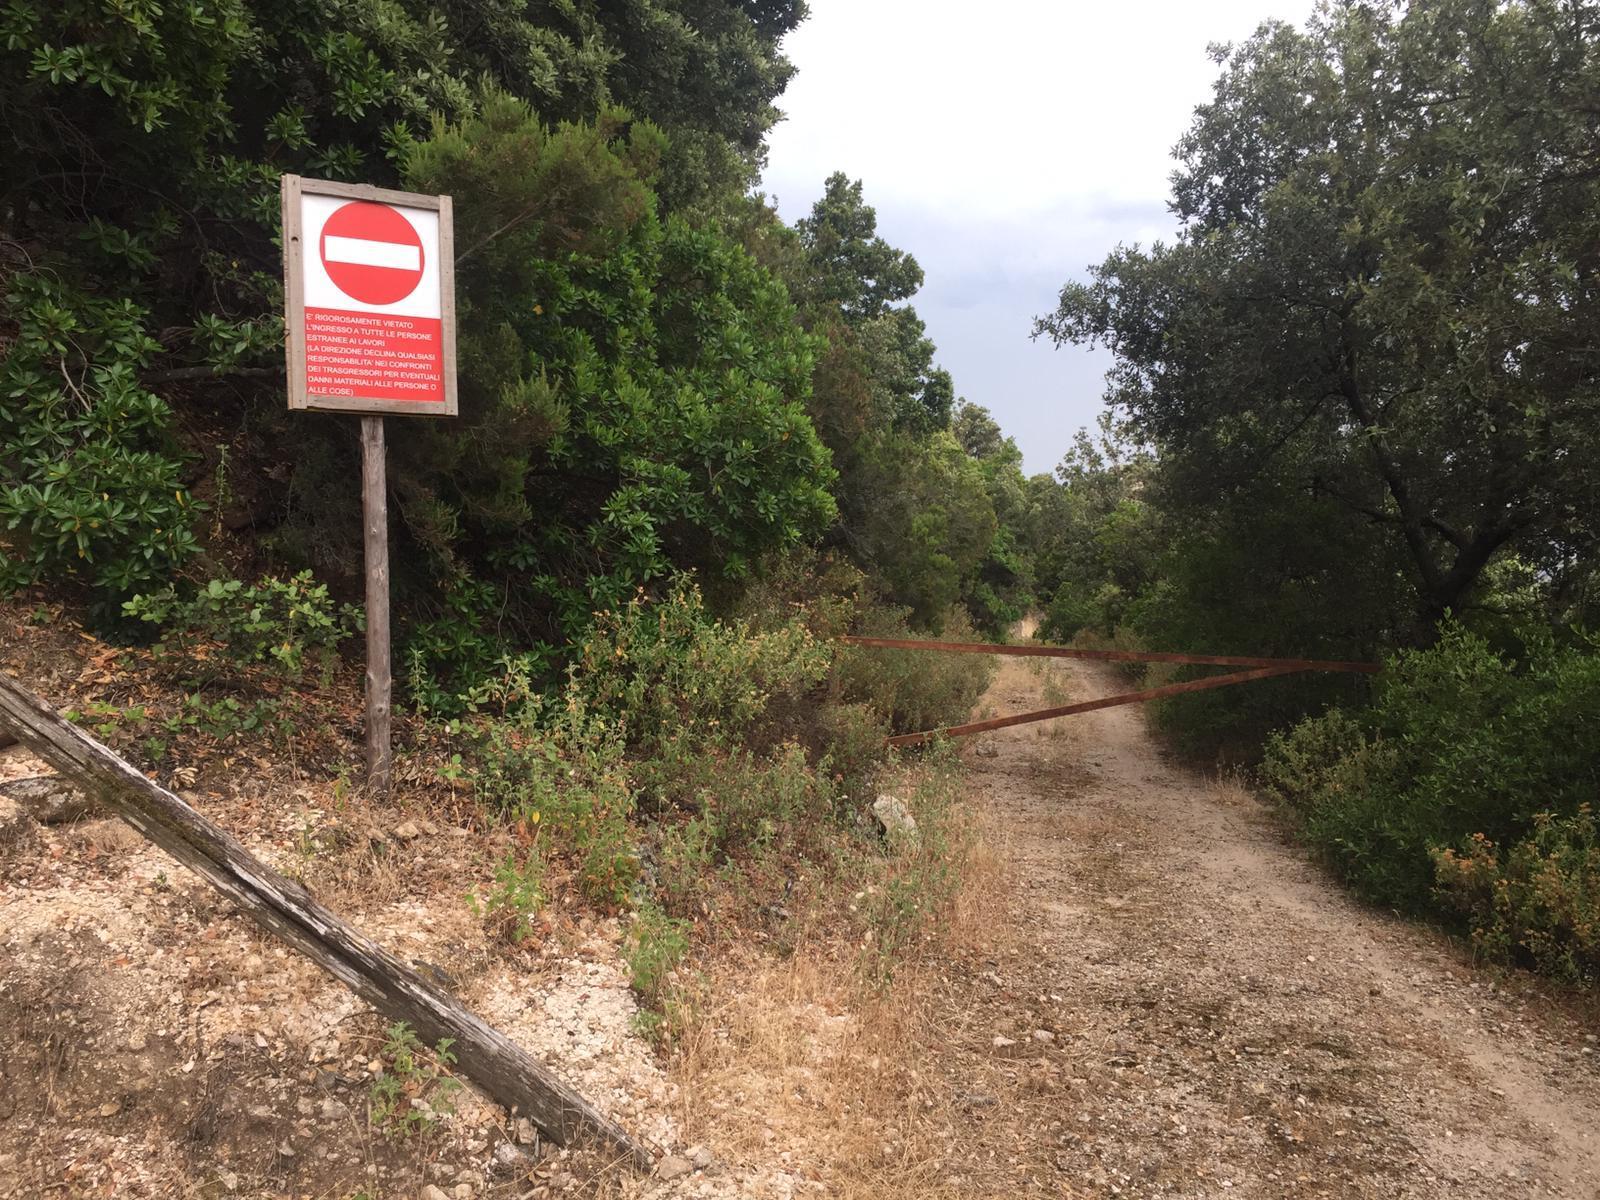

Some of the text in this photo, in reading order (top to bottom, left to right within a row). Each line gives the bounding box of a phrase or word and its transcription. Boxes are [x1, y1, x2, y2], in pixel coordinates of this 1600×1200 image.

[315, 313, 382, 326] RIGOROSAMENTE
[383, 320, 414, 329] VIETATO
[306, 324, 352, 334] L'INGRESSO
[361, 328, 384, 336] TUTTE
[396, 331, 432, 340] PERSONE
[306, 334, 349, 344] ESTRANEE
[358, 338, 385, 346] LAVORI
[321, 346, 362, 355] DIREZIONE
[364, 349, 396, 358] DECLINA
[398, 351, 436, 360] QUALSIASI
[307, 355, 374, 366] RESPONSABILITA'
[389, 361, 432, 370] CONFRONTI
[322, 366, 382, 377] TRASGRESSORI
[384, 370, 398, 378] PER
[400, 371, 440, 380] EVENTUALI
[308, 376, 332, 384] DANNI
[334, 378, 373, 387] MATERIALI
[394, 382, 429, 390] PERSONE
[329, 387, 354, 397] COSE)
